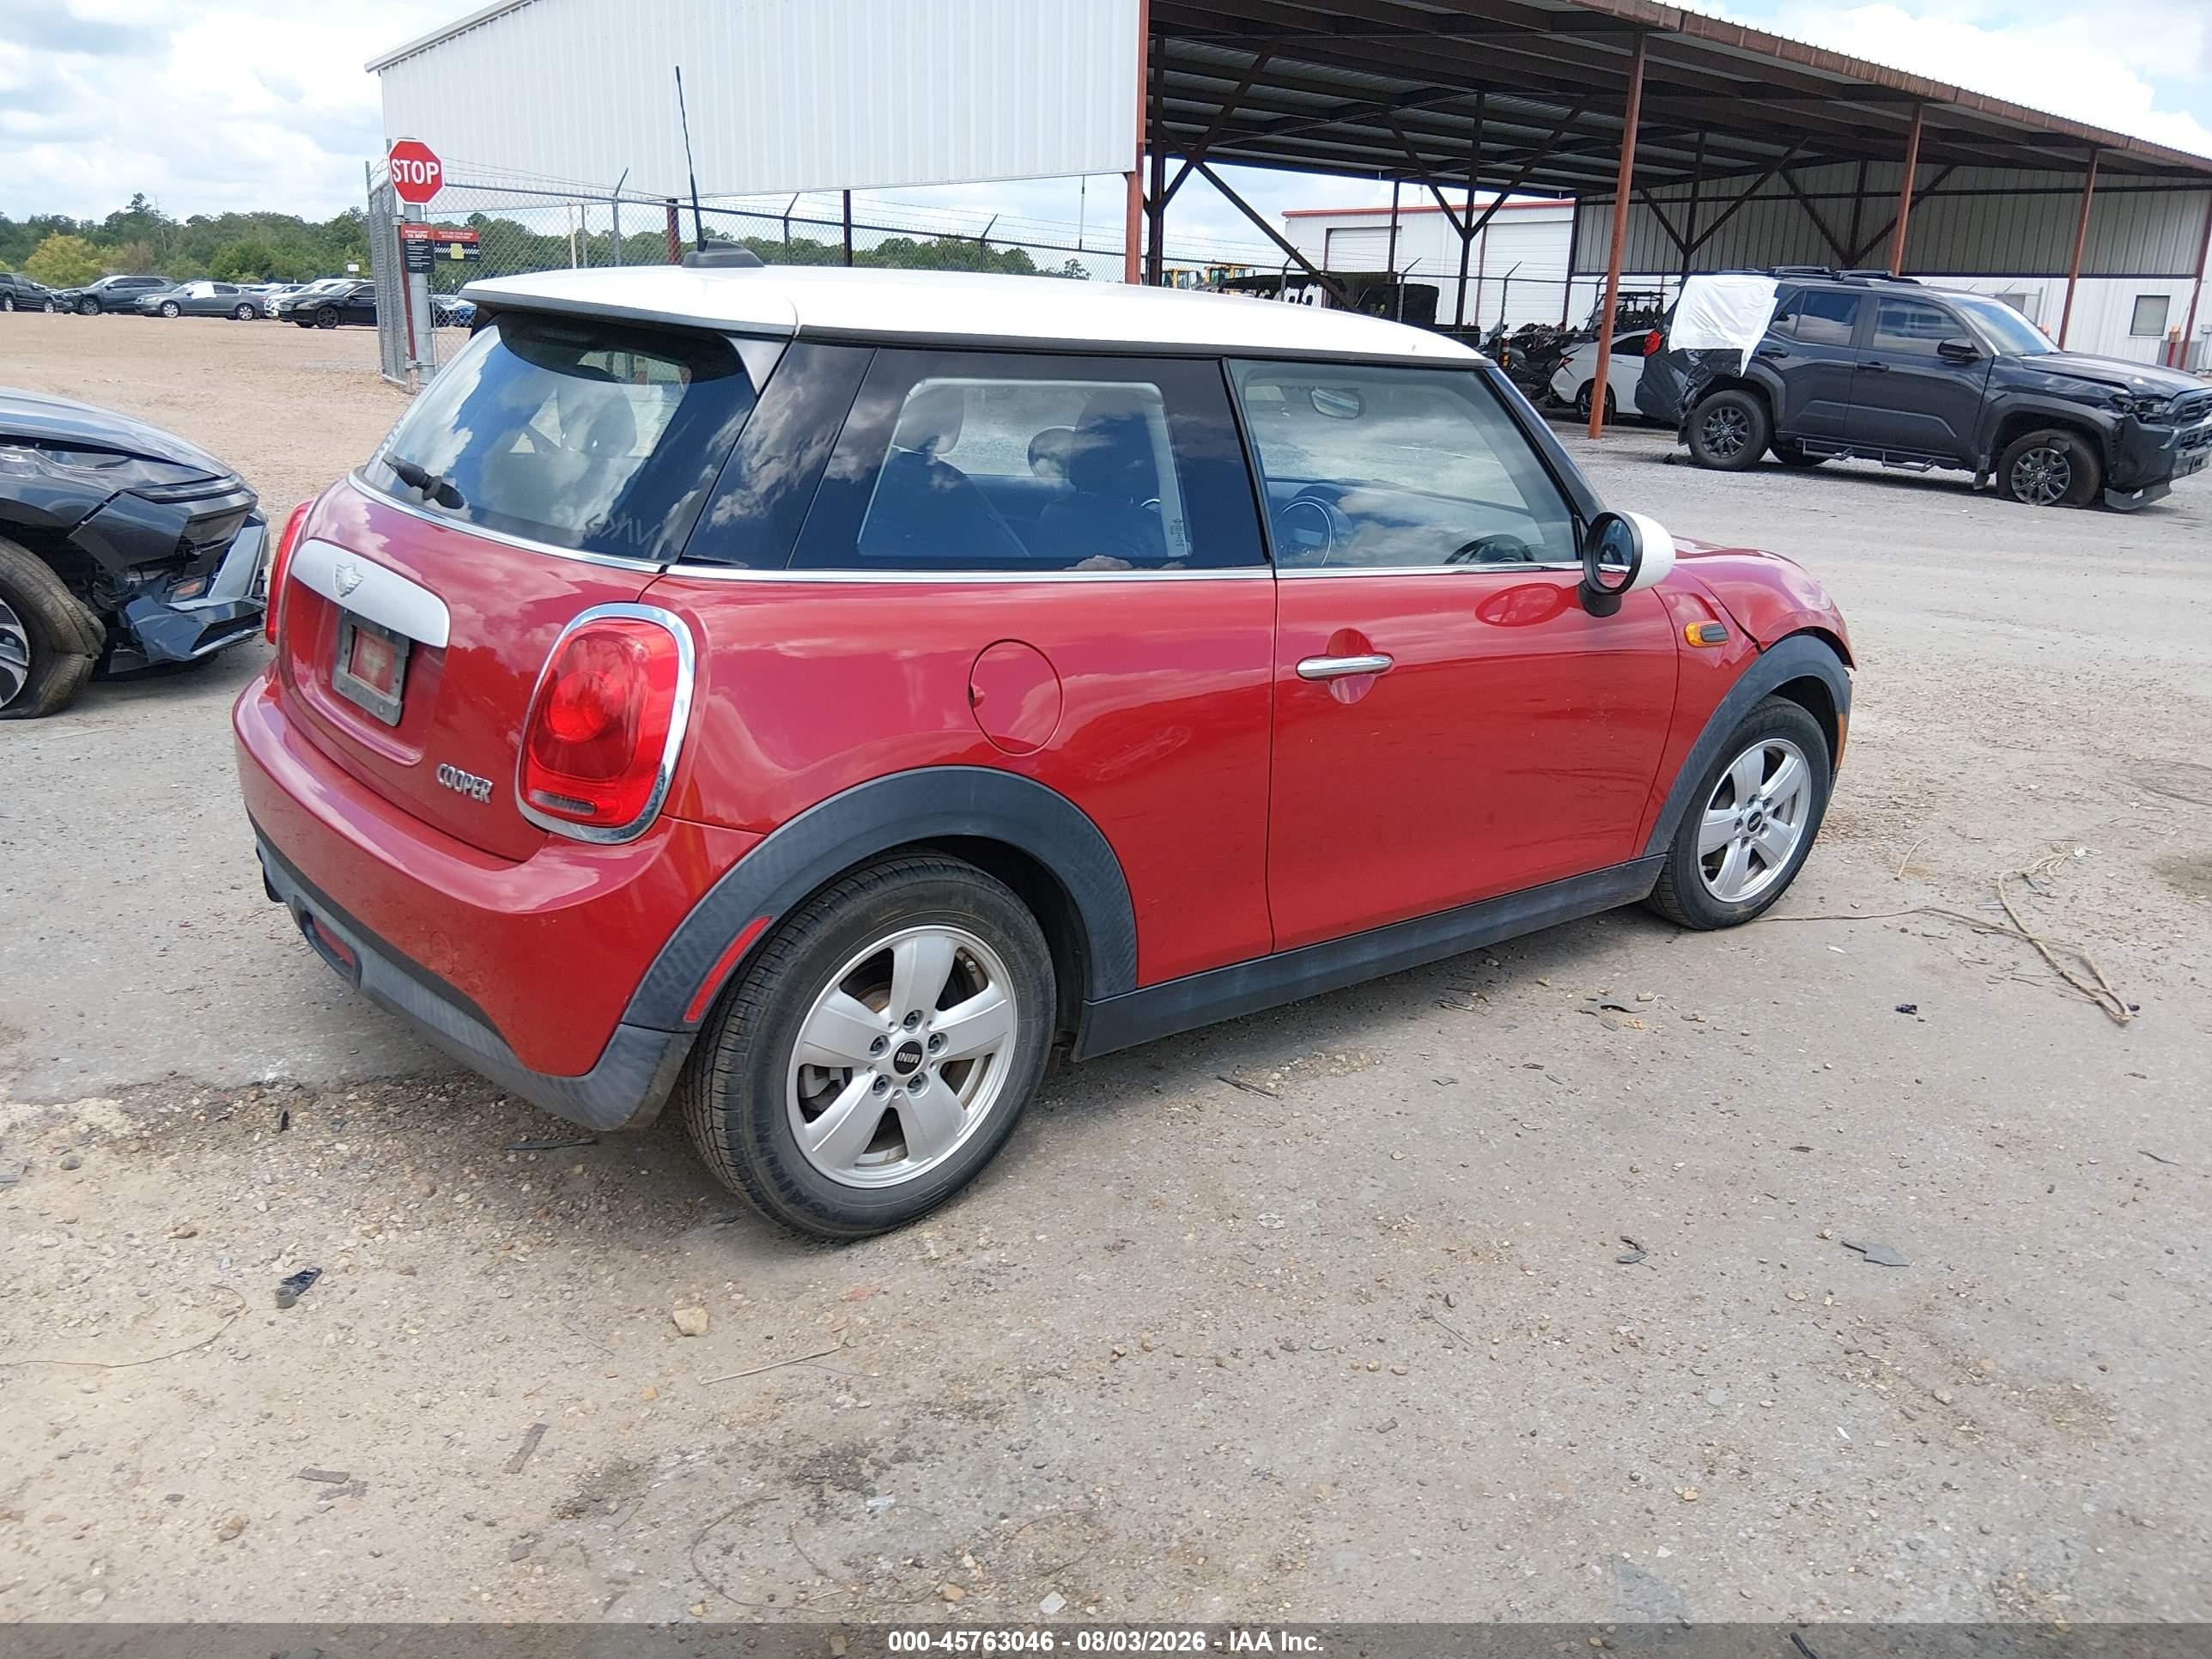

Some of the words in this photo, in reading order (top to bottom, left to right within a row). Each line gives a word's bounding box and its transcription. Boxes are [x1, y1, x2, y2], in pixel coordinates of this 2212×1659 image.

[391, 158, 440, 185] STOP
[436, 763, 494, 803] COOPER
[896, 1051, 921, 1064] MINI
